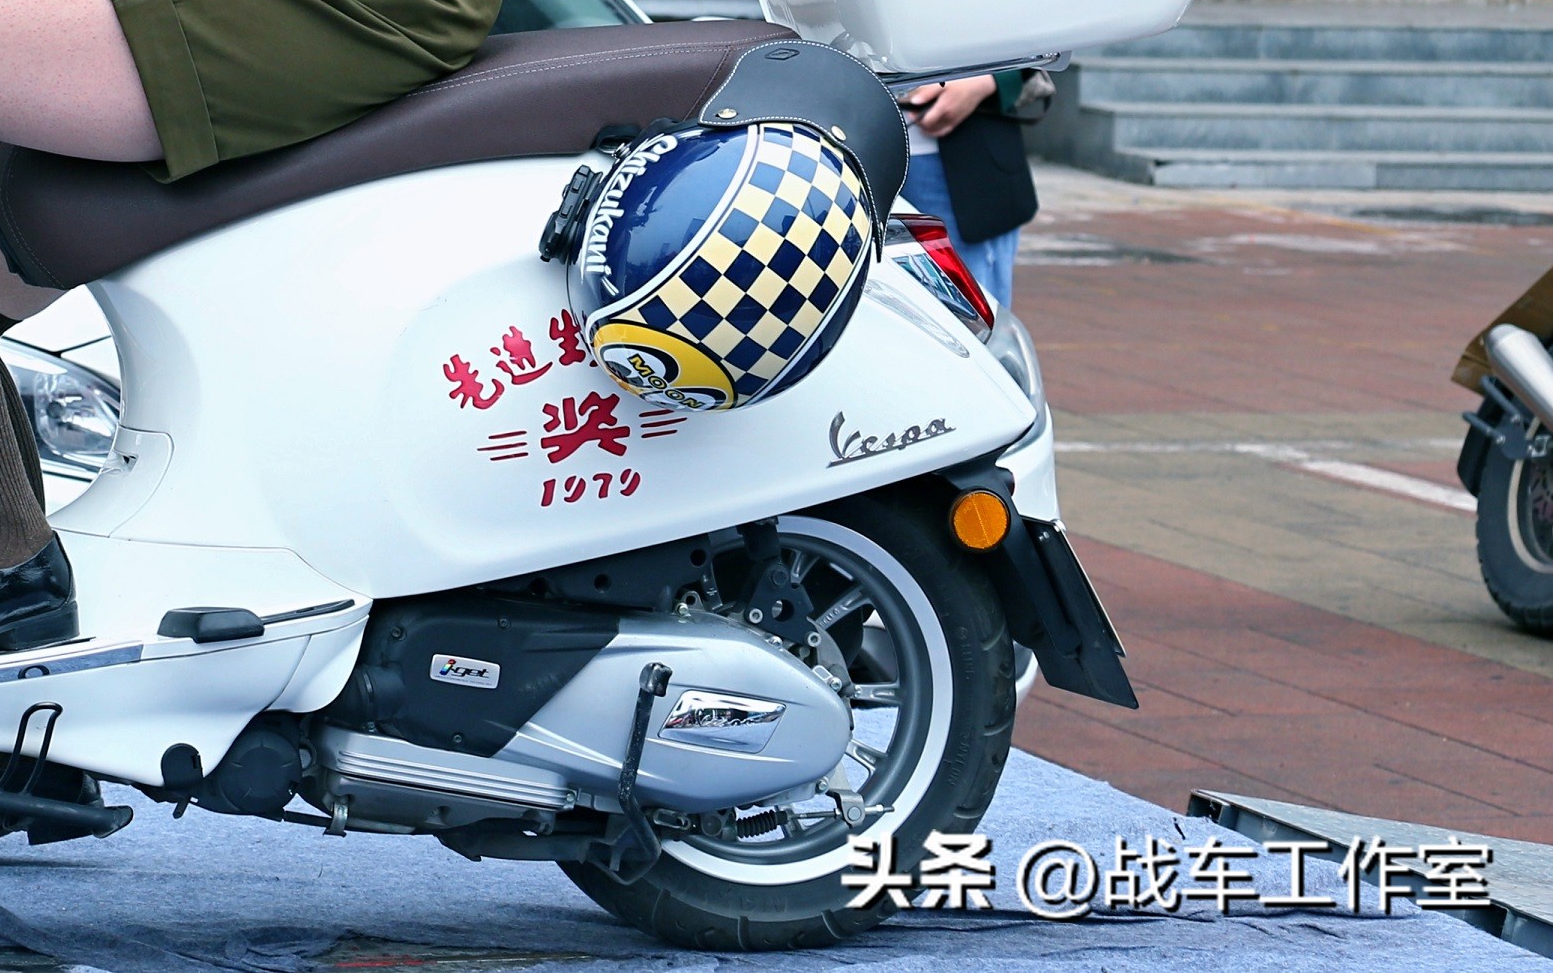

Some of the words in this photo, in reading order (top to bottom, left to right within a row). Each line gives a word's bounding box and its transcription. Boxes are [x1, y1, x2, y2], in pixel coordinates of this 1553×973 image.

[627, 353, 705, 410] MOON
[540, 391, 631, 463] 奖
[826, 410, 957, 468] Vespa
[540, 468, 641, 507] 1979
